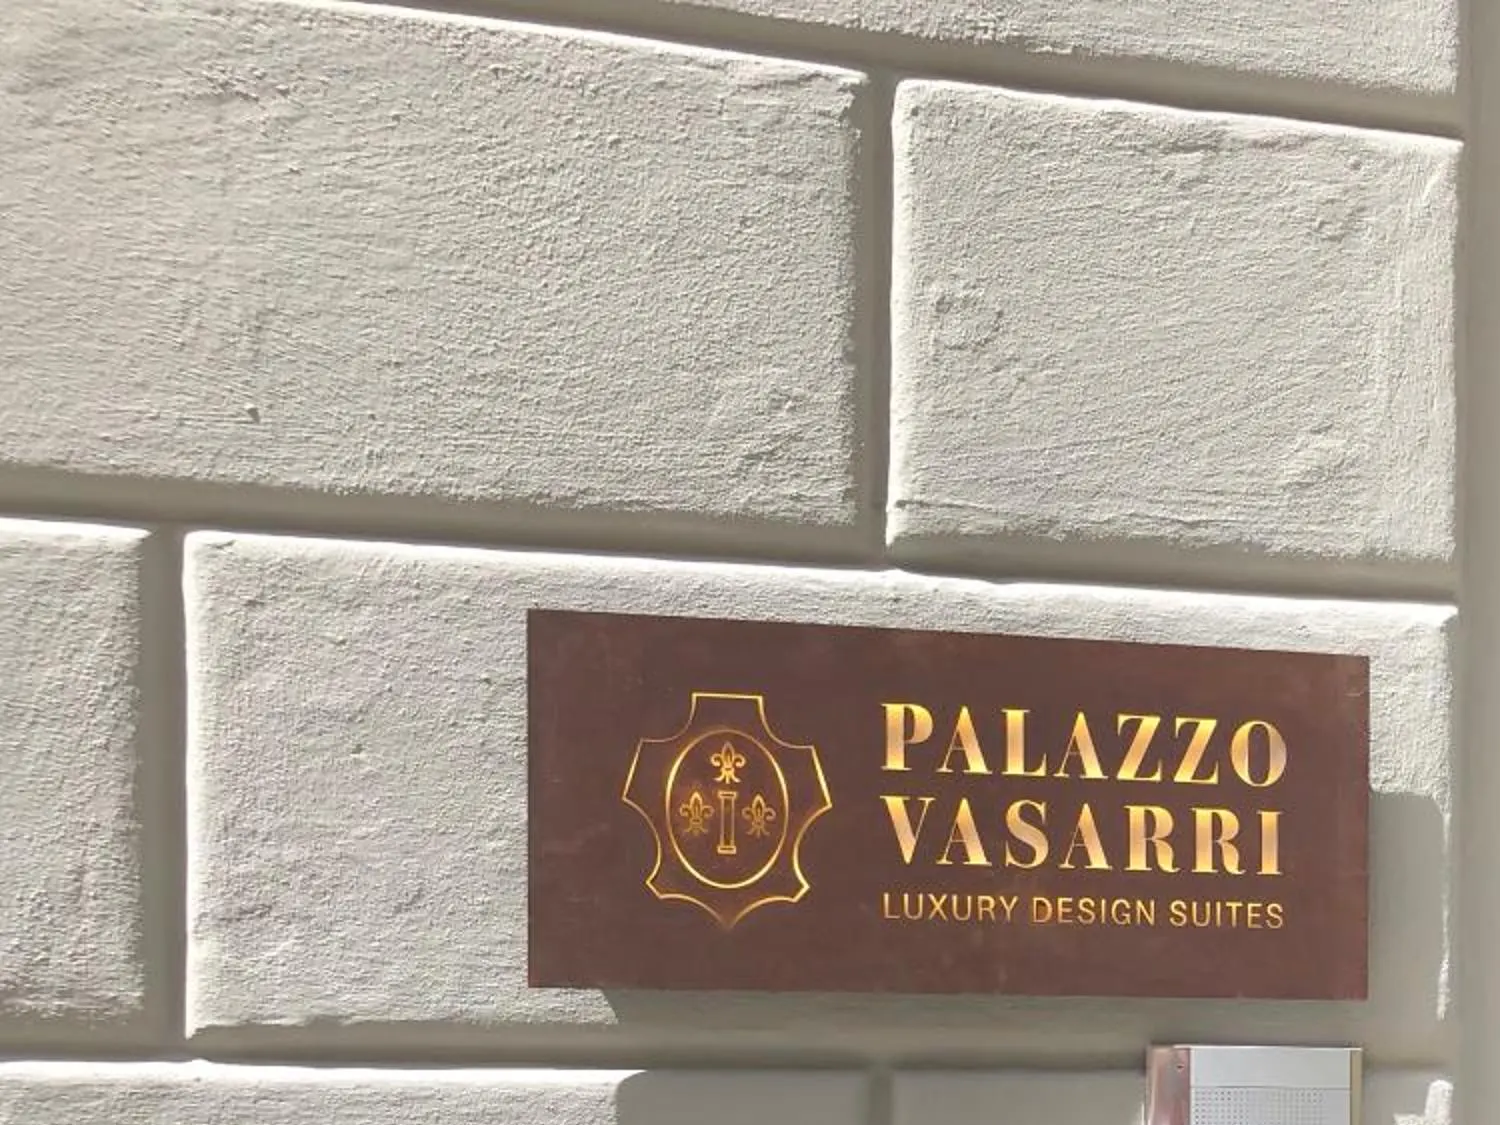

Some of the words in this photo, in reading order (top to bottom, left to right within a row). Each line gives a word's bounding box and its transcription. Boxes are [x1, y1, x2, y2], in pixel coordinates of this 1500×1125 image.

[881, 702, 1288, 787] PALAZZO
[881, 795, 1284, 876] VASARRI
[882, 892, 1016, 924] LUXURY
[1032, 896, 1156, 927] DESIGN
[1168, 900, 1285, 930] SUITES
